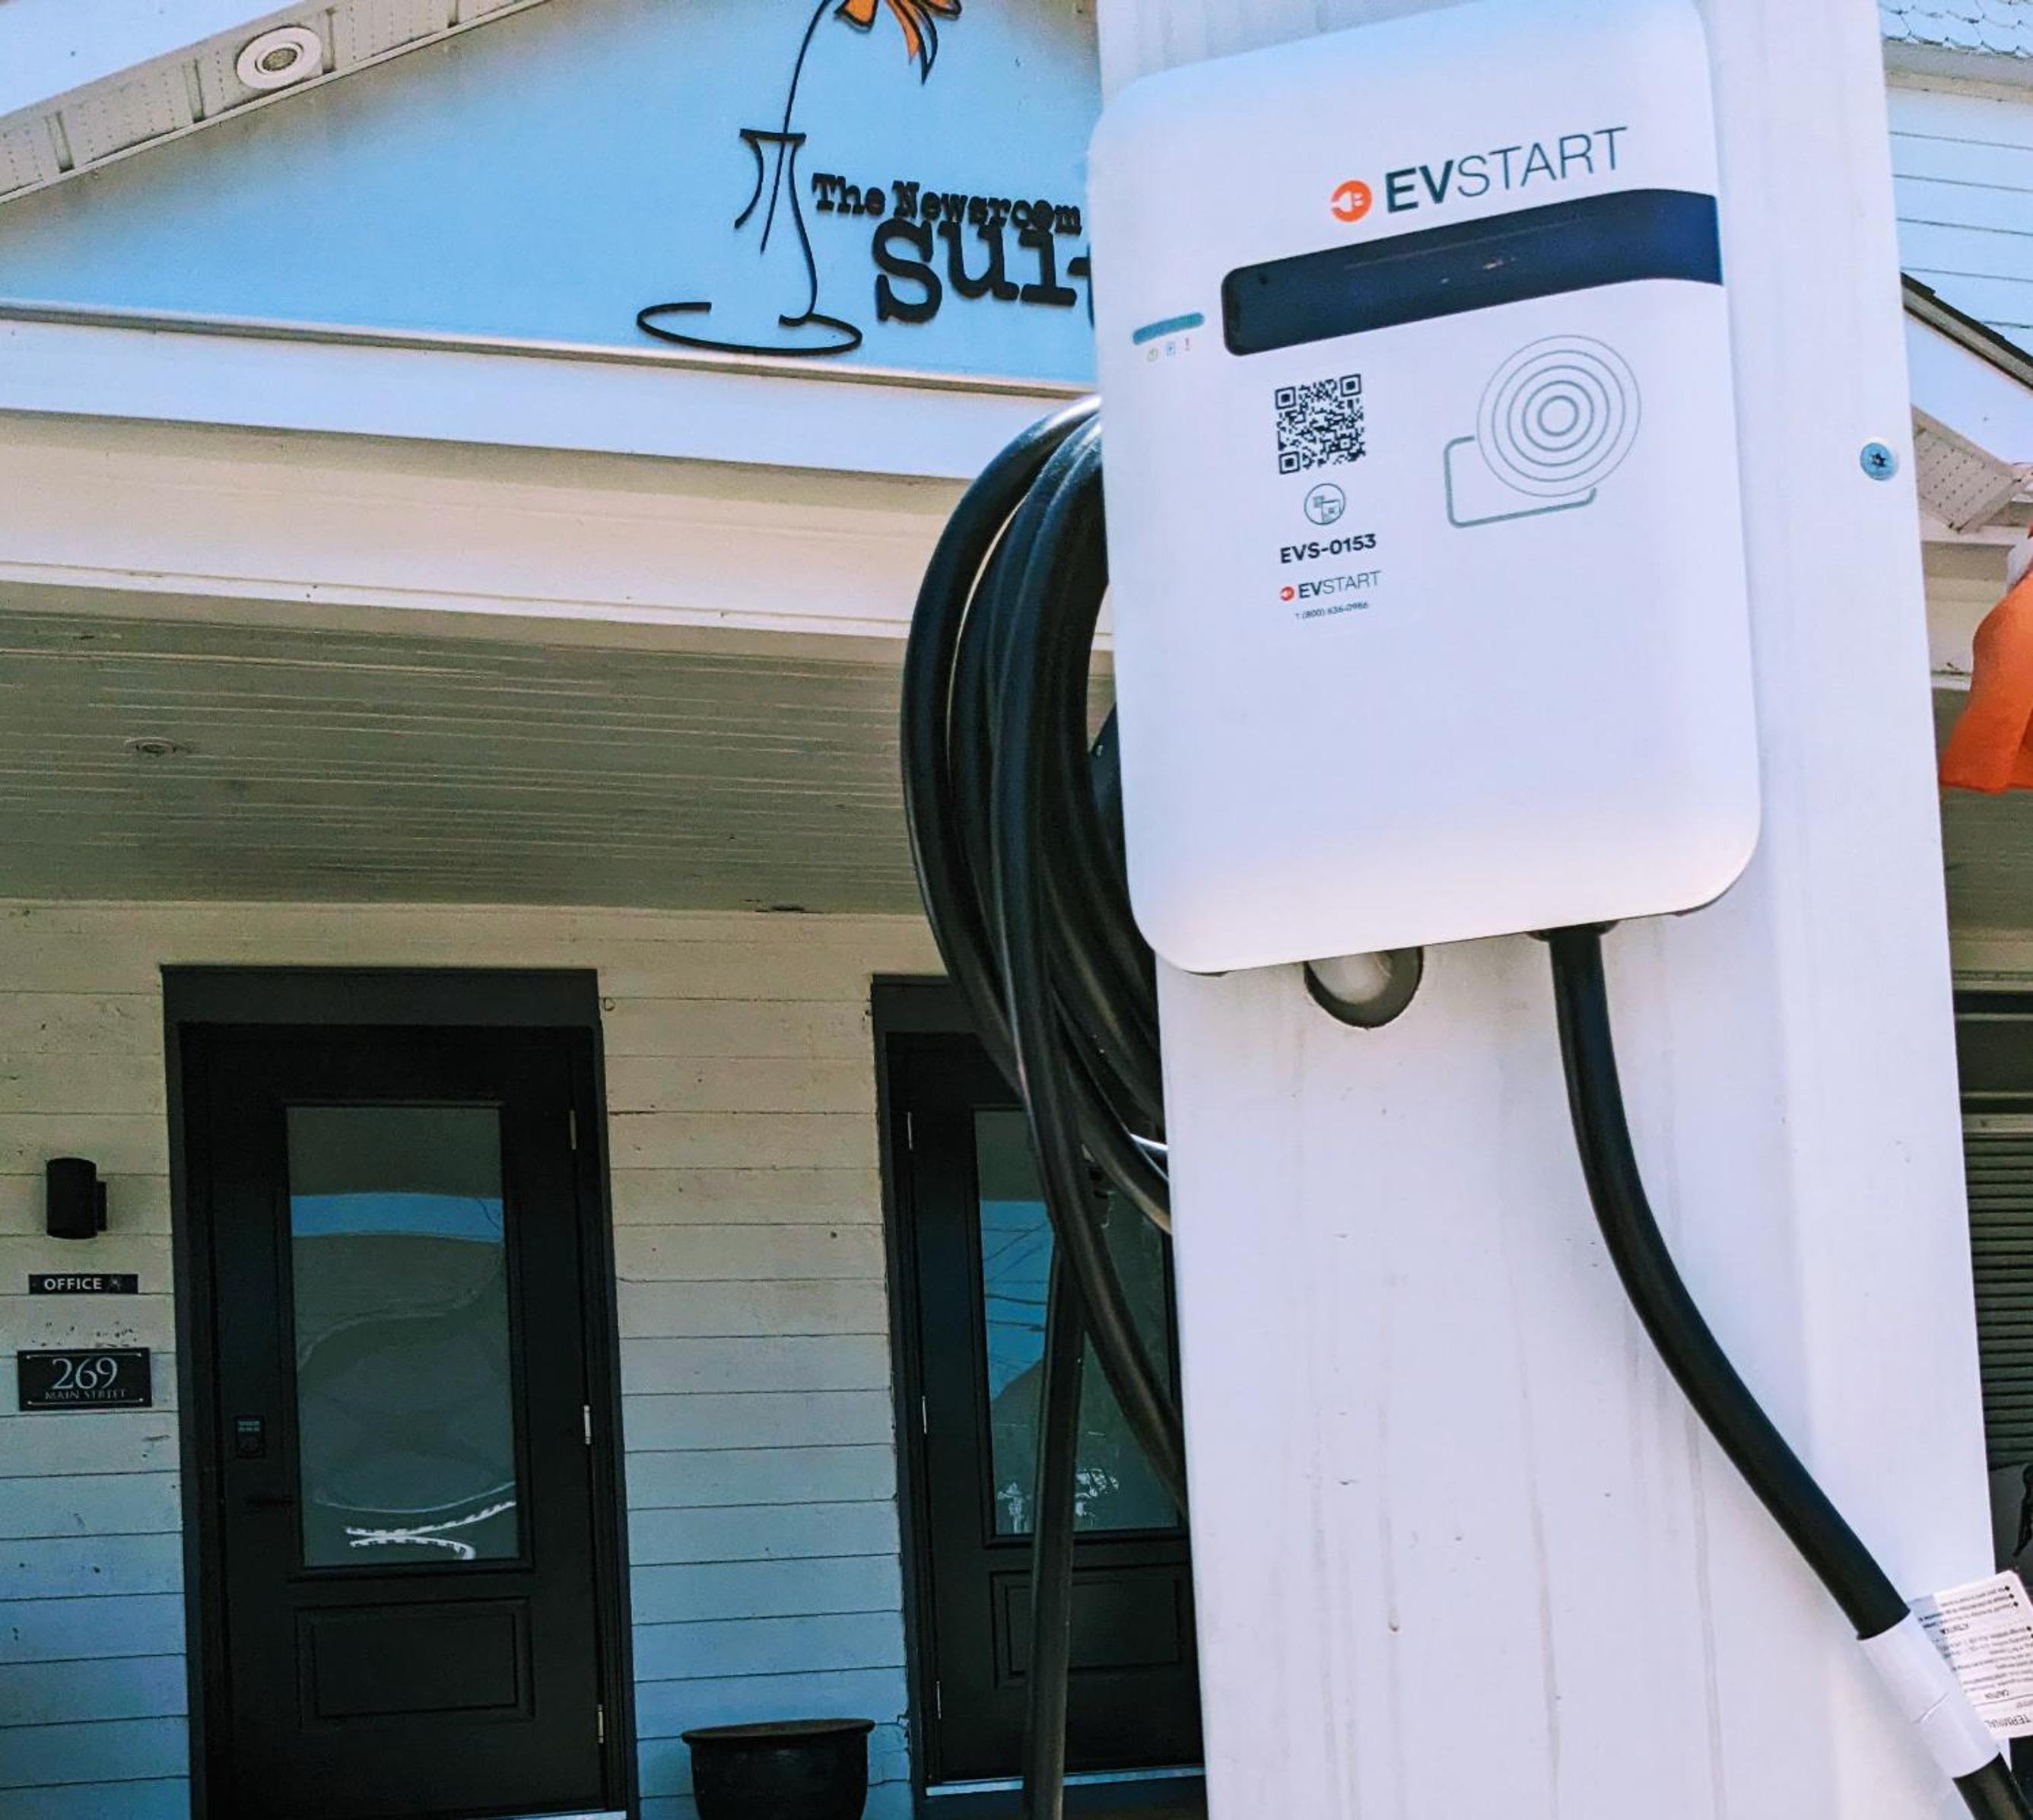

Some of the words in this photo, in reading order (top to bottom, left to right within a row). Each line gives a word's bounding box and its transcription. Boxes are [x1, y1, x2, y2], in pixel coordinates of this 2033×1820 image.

[1385, 126, 1627, 213] EVSTART
[812, 173, 886, 216] The
[892, 180, 1082, 235] Newsroom
[1280, 533, 1377, 564] EVS-0153
[1298, 570, 1381, 599] EVSTART
[44, 1278, 103, 1291] OFFICE
[52, 1357, 118, 1390] 269
[45, 1390, 79, 1399] MAIN
